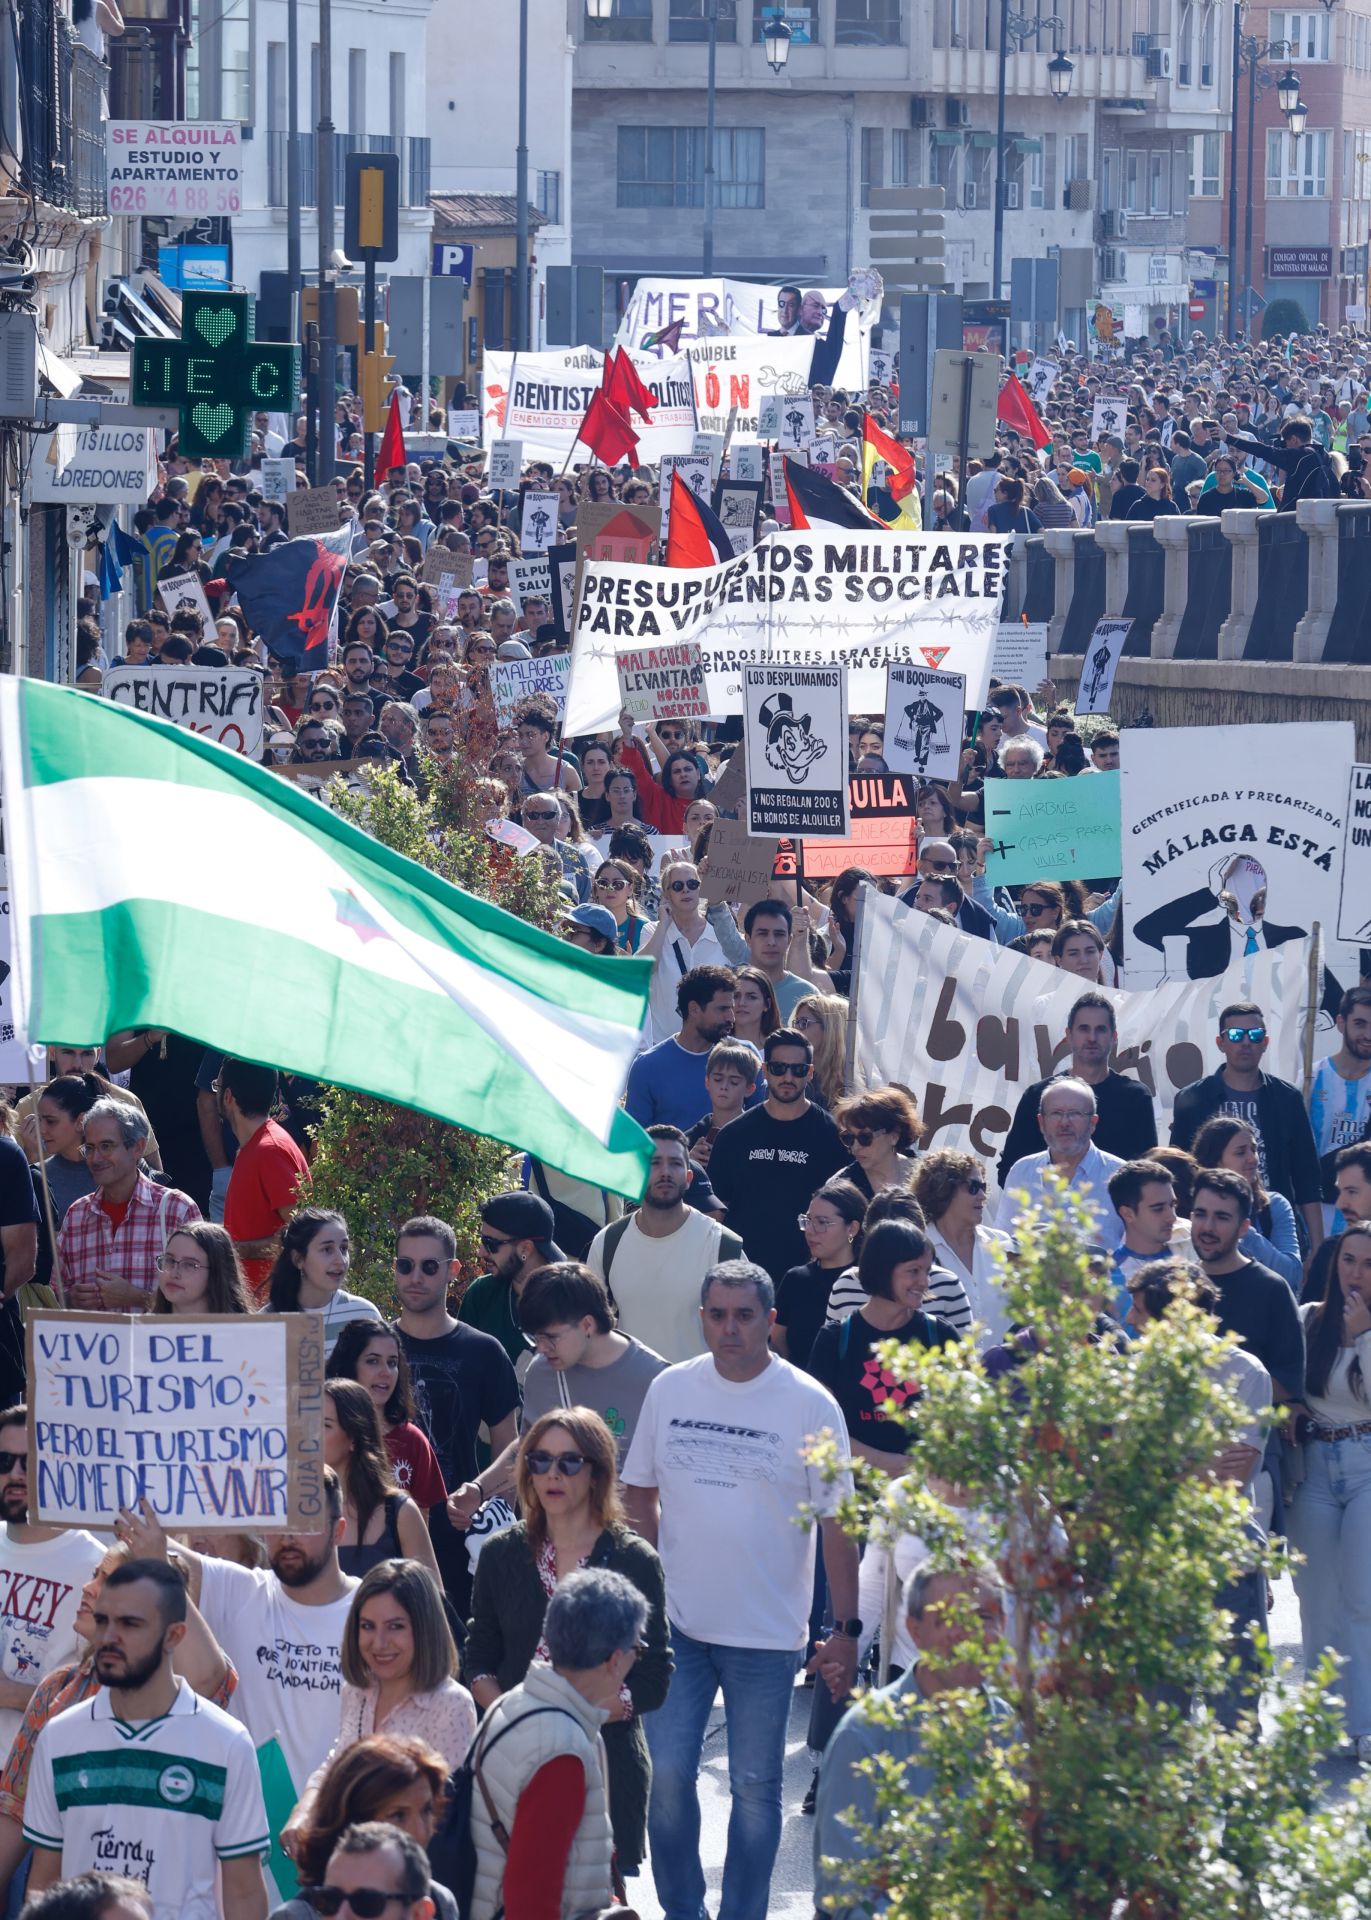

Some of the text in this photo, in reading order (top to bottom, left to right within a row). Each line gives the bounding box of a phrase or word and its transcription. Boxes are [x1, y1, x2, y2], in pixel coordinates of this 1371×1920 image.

[112, 128, 237, 145] SE ALQUILA
[128, 151, 221, 164] ESTUDIO Y
[110, 167, 239, 181] APARTAMENTO
[110, 186, 147, 211] 626
[185, 187, 209, 211] 88
[216, 187, 241, 212] 56
[441, 245, 464, 275] P
[1273, 253, 1328, 262] COLEGIO OFICIAL DE
[1273, 261, 1329, 272] DENTISTAS DE MÁLAGA
[513, 413, 567, 426] ENEMIGOS
[663, 456, 710, 468] SIN BOQUERONES
[515, 567, 529, 578] EL
[577, 603, 661, 637] PARA
[702, 642, 910, 663] ONDOS BUITRES ISRAELÍS
[748, 670, 839, 687] LOS DESPLUMAMOS
[891, 671, 963, 690] SIN BOQUERONES
[656, 687, 700, 702] HOGAR
[754, 794, 760, 805] Y
[760, 794, 776, 806] NOS
[776, 795, 812, 808] REGALAN
[814, 796, 831, 809] 200
[752, 812, 841, 827] EN BONOS DE ALQUILER
[1131, 790, 1341, 836] GENTRIFICADA Y PRECARIZADA
[1141, 824, 1337, 876] MÁLAGA ESTÁ
[749, 1148, 809, 1165] NEW YORK
[39, 1332, 223, 1365] VIVO DEL
[55, 1373, 257, 1416] TURISMO,
[36, 1421, 288, 1463] PERO EL TURISMO
[38, 1460, 288, 1518] NO ME DEJA VIVIR
